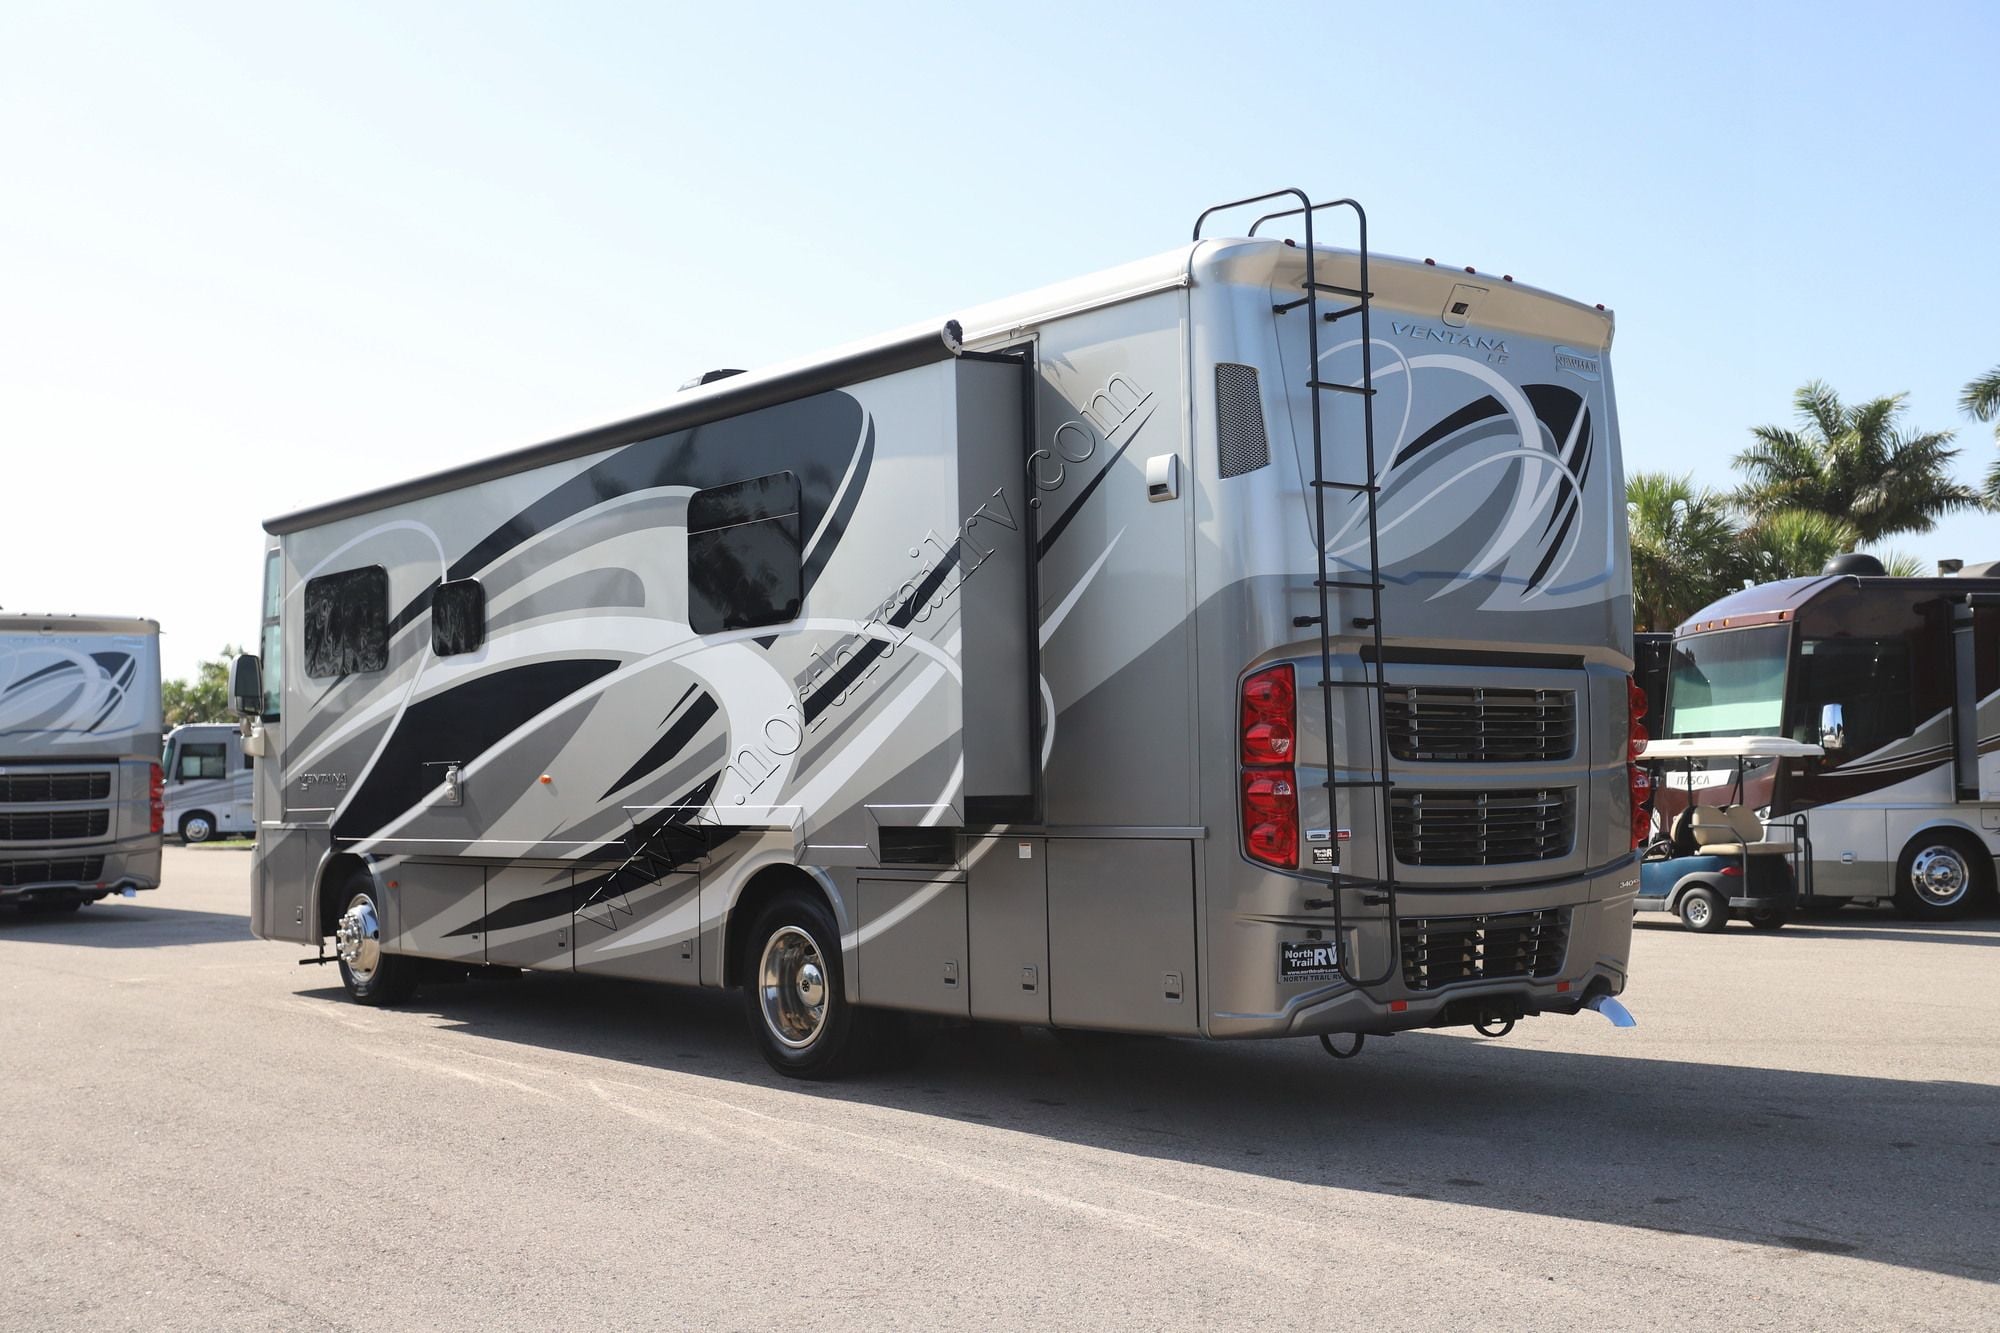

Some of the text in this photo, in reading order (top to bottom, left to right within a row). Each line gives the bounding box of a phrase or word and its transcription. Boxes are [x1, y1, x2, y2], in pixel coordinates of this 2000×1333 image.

[1391, 321, 1509, 353] VENTANA
[1487, 353, 1509, 365] LE
[299, 772, 348, 785] VENTANA
[1285, 949, 1313, 959] North
[1313, 946, 1338, 966] RV
[1290, 958, 1313, 967] Trail
[1283, 975, 1308, 983] NORTH
[1311, 974, 1331, 982] TRAIL
